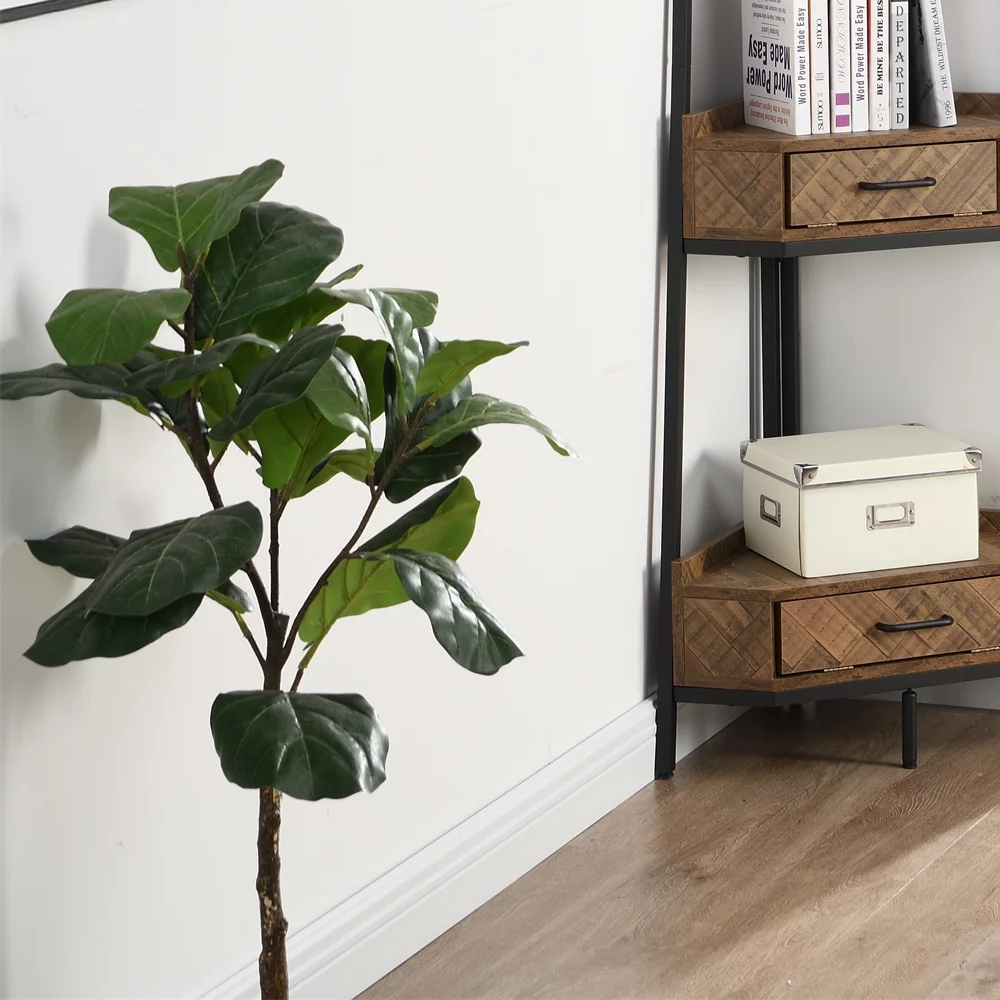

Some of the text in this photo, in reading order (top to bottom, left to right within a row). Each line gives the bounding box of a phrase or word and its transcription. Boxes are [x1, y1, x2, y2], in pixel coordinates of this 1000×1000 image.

[797, 8, 806, 27] Easy
[932, 7, 940, 35] DREAM
[748, 34, 790, 70] Made Easy
[797, 30, 805, 52] Made
[855, 5, 865, 101] Word Power Made Easy
[877, 40, 883, 52] BE
[936, 37, 945, 71] WILDEST
[895, 6, 905, 124] DEPARTED
[746, 66, 792, 99] Word Power
[877, 83, 883, 95] BE
[944, 101, 952, 119] 1996
